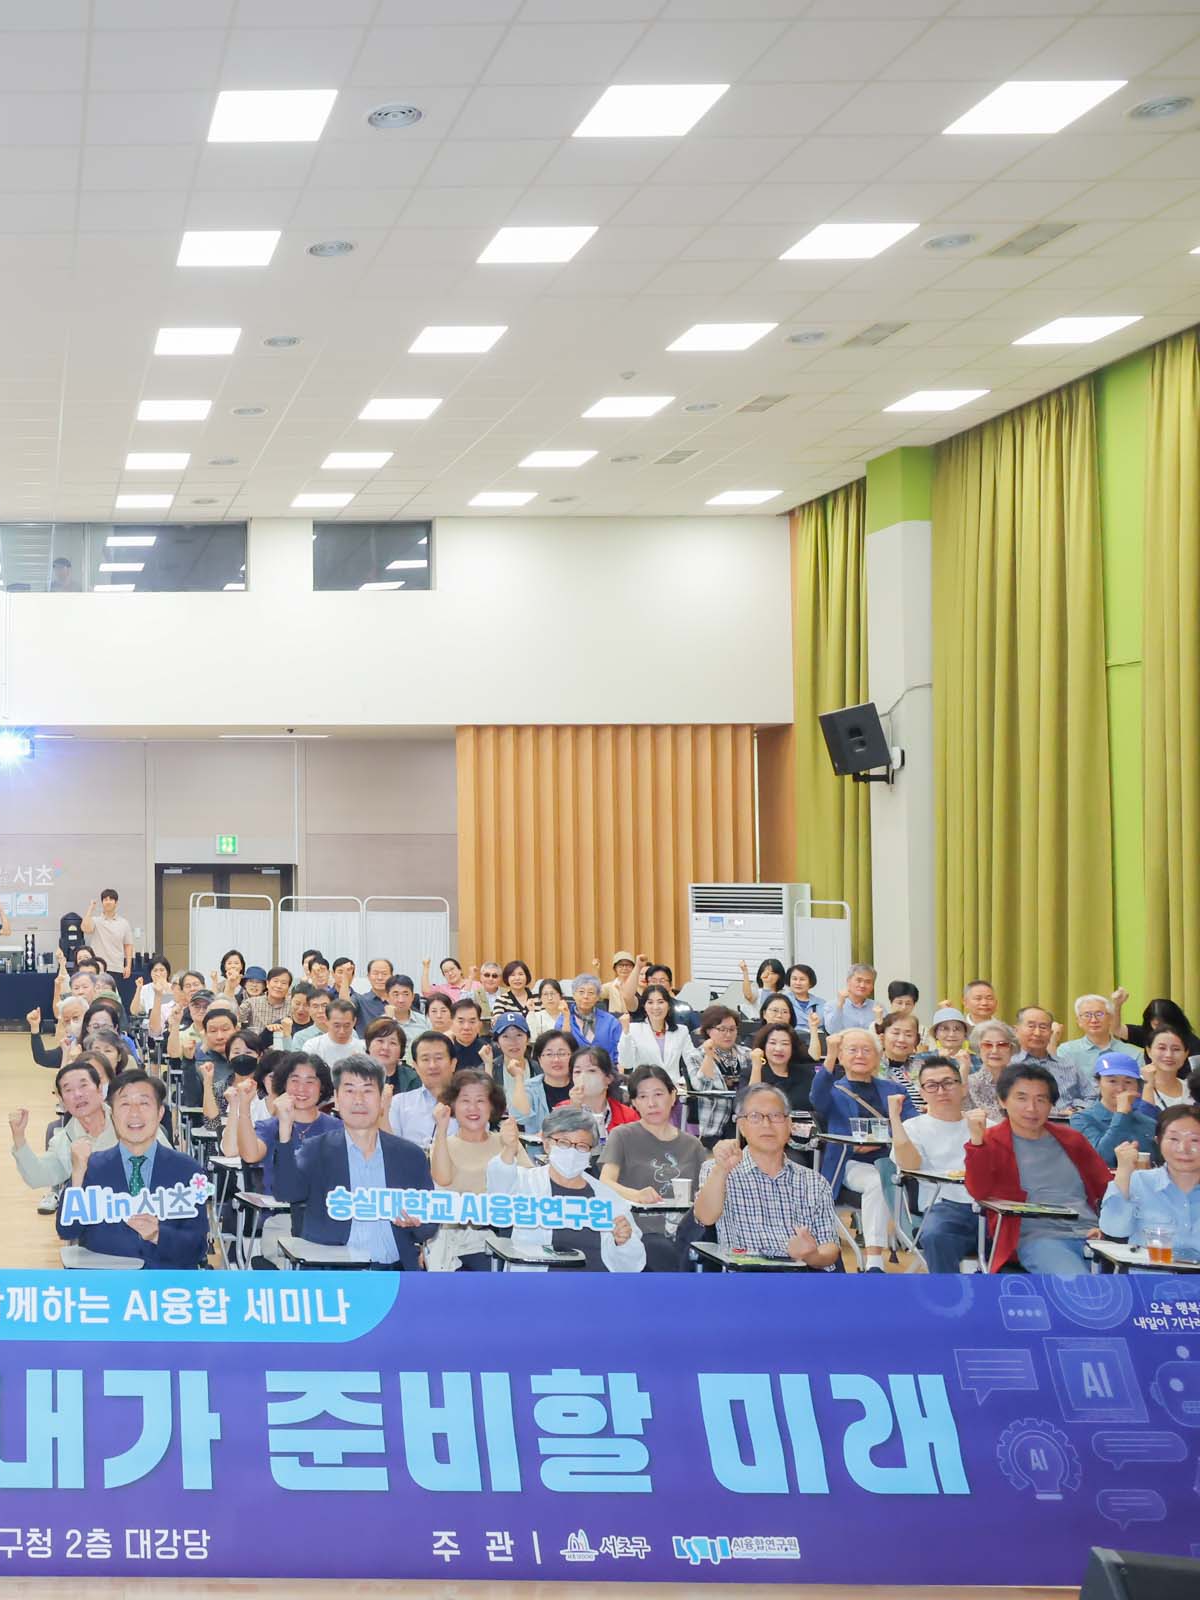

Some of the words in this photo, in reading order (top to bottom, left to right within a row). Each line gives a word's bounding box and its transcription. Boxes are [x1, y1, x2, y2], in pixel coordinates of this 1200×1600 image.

[14, 864, 54, 887] 서초
[63, 1189, 97, 1223] AI
[106, 1193, 131, 1219] in
[137, 1185, 196, 1218] 서초
[328, 1188, 454, 1221] 숭실대학교
[460, 1194, 614, 1229] AI융합연구원
[123, 1287, 230, 1325] AI융합
[244, 1289, 350, 1325] 세미나
[1150, 1302, 1173, 1315] 오늘
[1175, 1302, 1200, 1315] 행복
[1133, 1316, 1169, 1330] 내일이
[1082, 1362, 1113, 1398] AI
[265, 1368, 653, 1493] 준비할
[697, 1373, 971, 1495] 미래
[1030, 1449, 1048, 1471] AI
[65, 1528, 113, 1559] 2층
[125, 1528, 211, 1560] 대강당
[601, 1535, 650, 1559] 서초구
